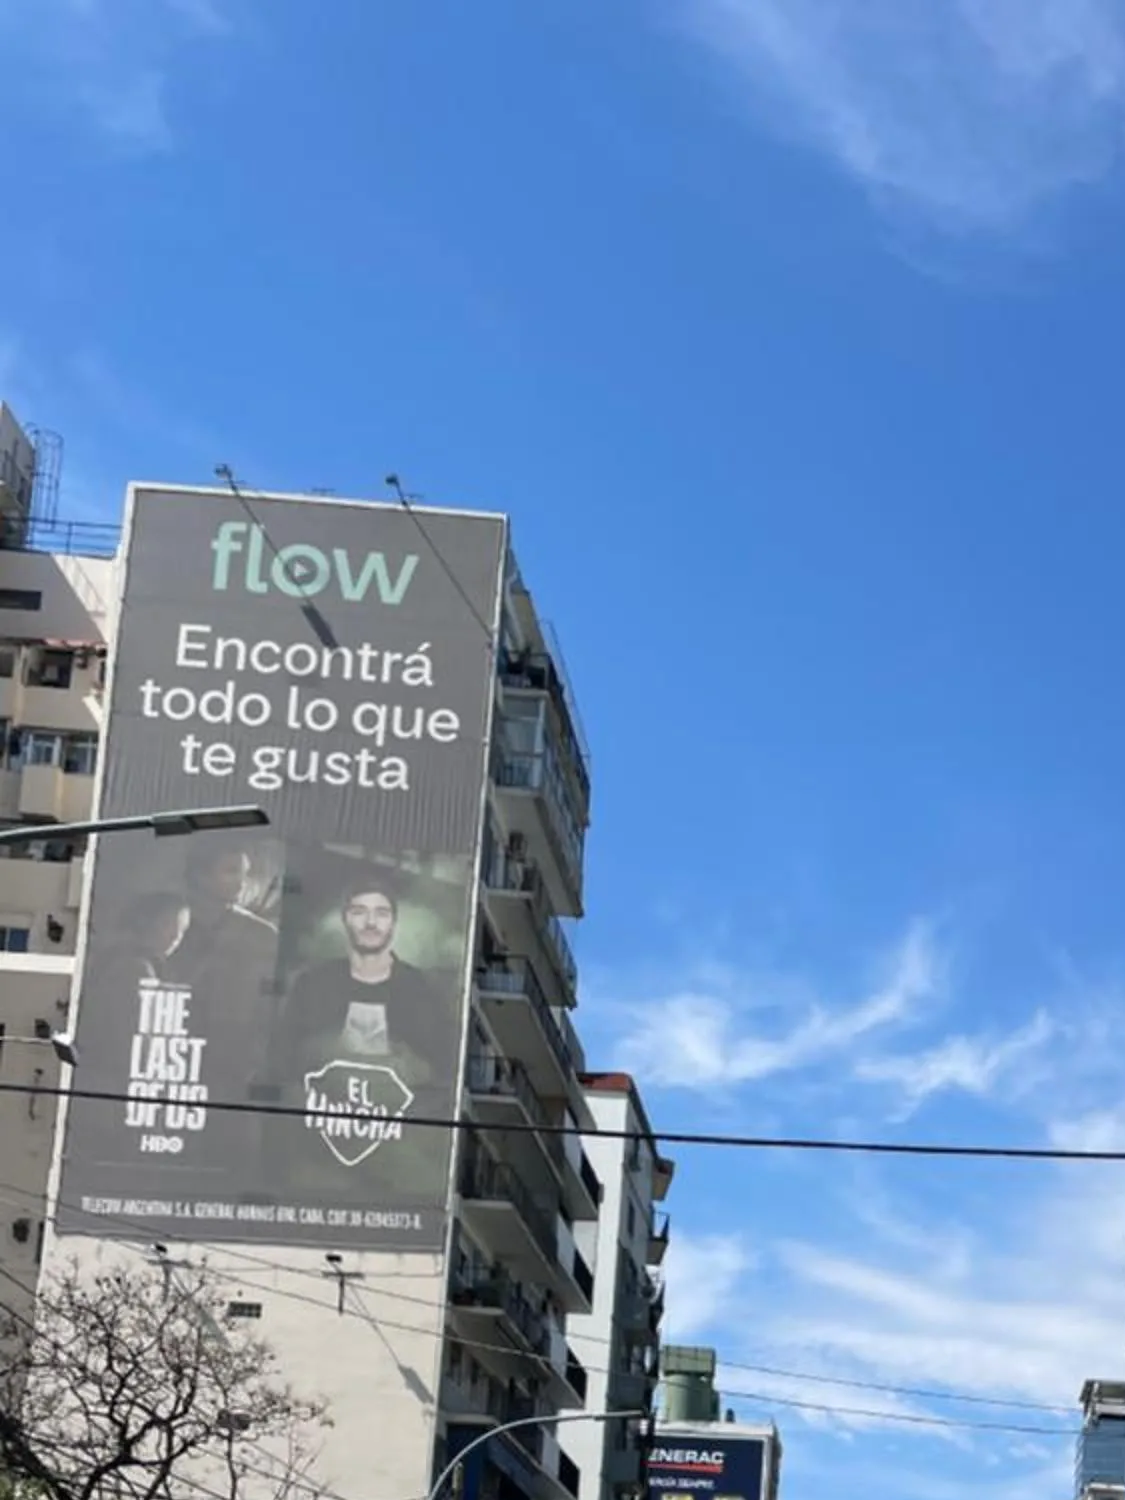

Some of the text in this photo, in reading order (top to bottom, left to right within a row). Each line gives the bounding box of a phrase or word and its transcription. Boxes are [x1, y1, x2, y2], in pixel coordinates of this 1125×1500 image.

[211, 521, 419, 604] flow
[176, 623, 434, 687] Encontrá
[139, 679, 460, 747] todo lo que
[181, 733, 409, 791] te gusta
[139, 988, 192, 1035] THE
[130, 1034, 206, 1082] LAST
[125, 1081, 208, 1131] OF US
[348, 1077, 373, 1108] EL
[140, 1134, 184, 1153] HBO
[122, 1199, 173, 1216] ARGENTINA
